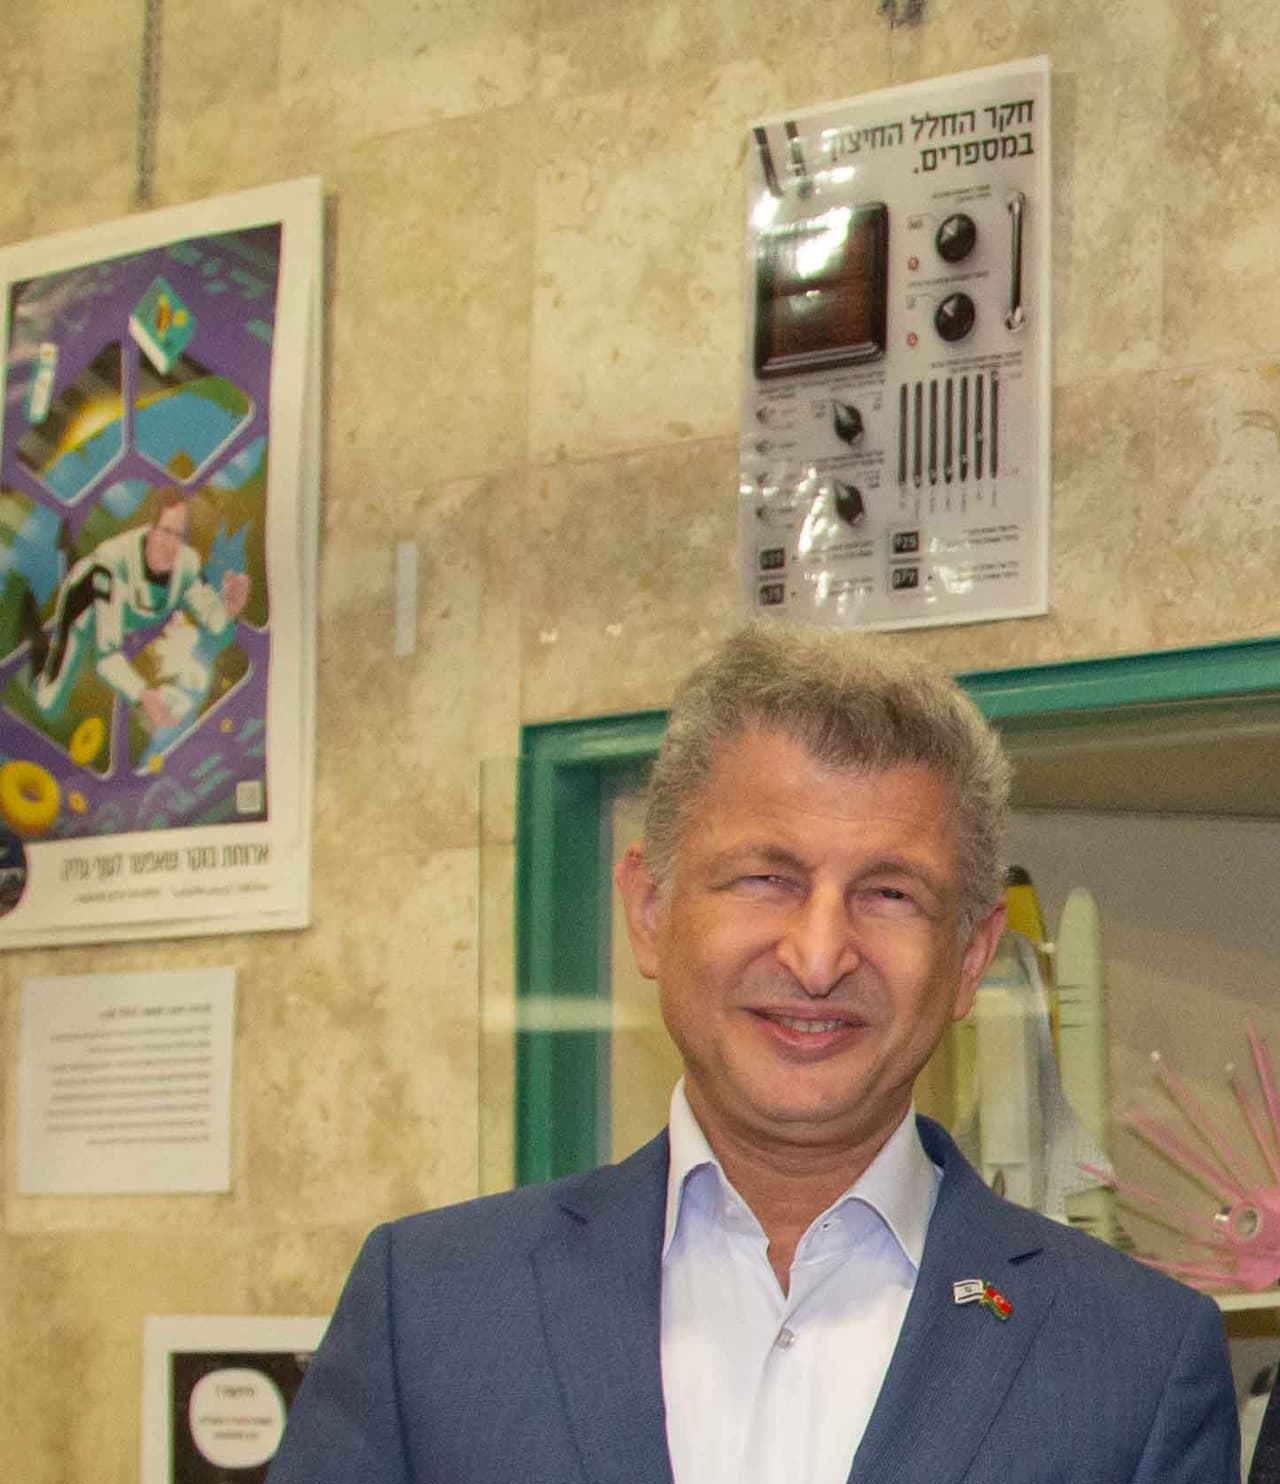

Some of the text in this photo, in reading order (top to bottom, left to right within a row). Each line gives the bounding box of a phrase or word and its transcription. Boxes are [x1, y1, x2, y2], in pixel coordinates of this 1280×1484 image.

[911, 110, 975, 141] החלל
[984, 99, 1035, 133] חקר
[913, 131, 1034, 175] במספרים.
